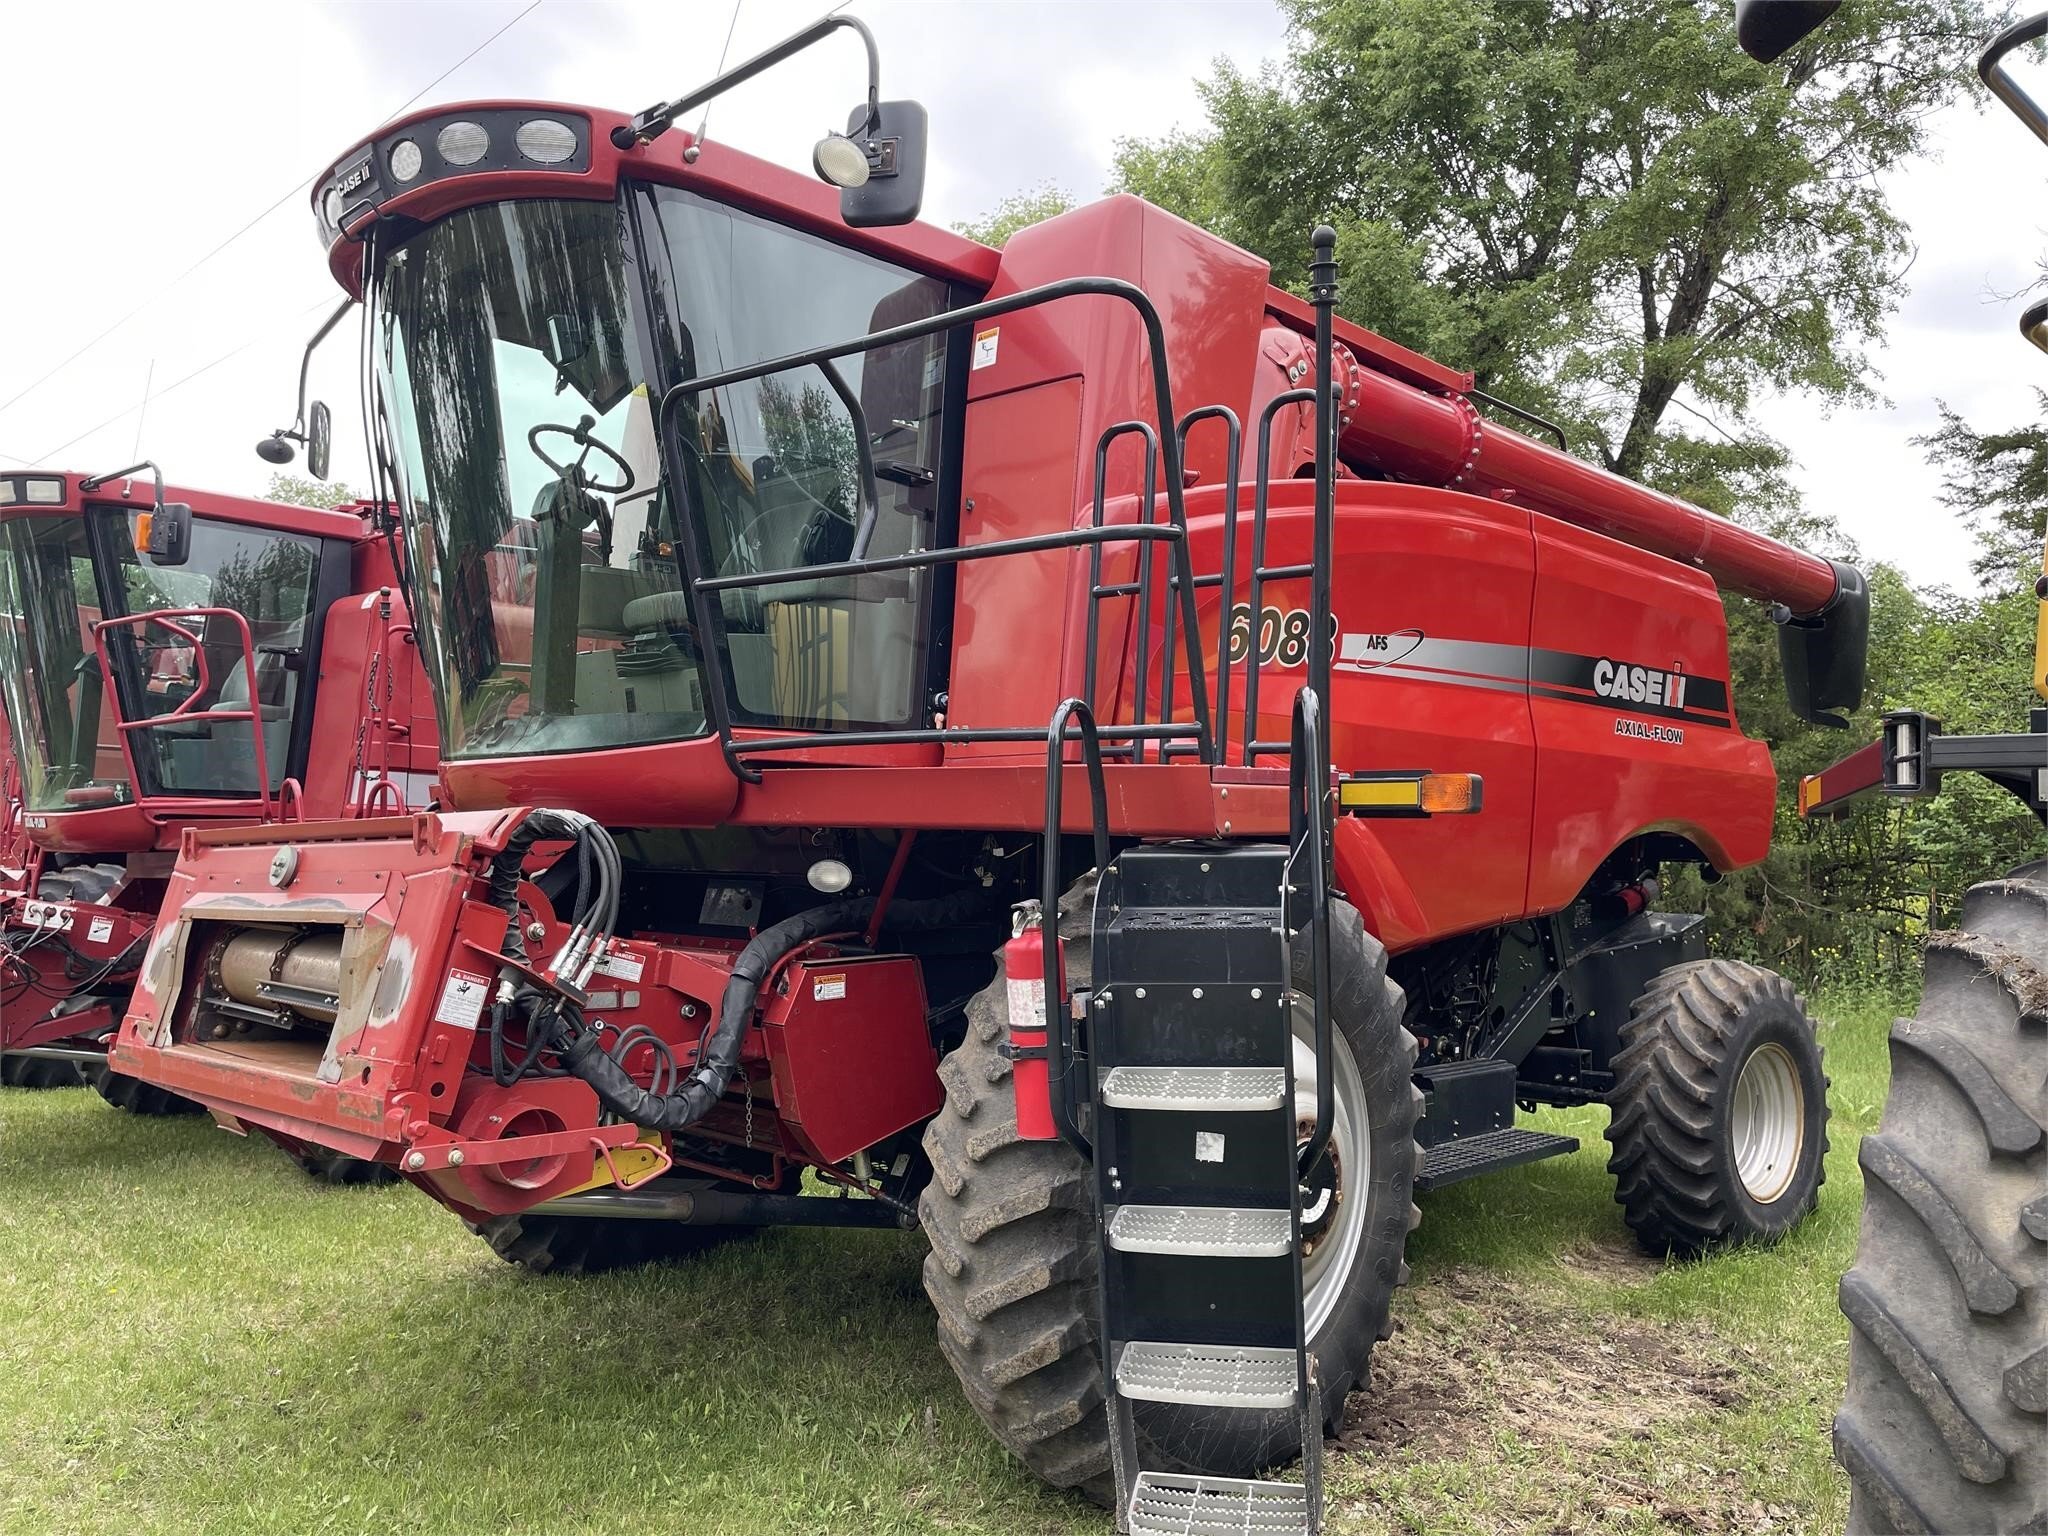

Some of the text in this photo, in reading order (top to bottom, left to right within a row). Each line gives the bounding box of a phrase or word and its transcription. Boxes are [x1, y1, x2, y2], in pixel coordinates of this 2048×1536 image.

[337, 171, 362, 198] CASE
[1218, 602, 1339, 668] 608
[1367, 634, 1389, 651] AFS
[1593, 659, 1664, 705] CASE
[1614, 718, 1684, 744] AXIAL-FLOW
[614, 951, 636, 961] DANGER
[462, 973, 485, 985] DANGER
